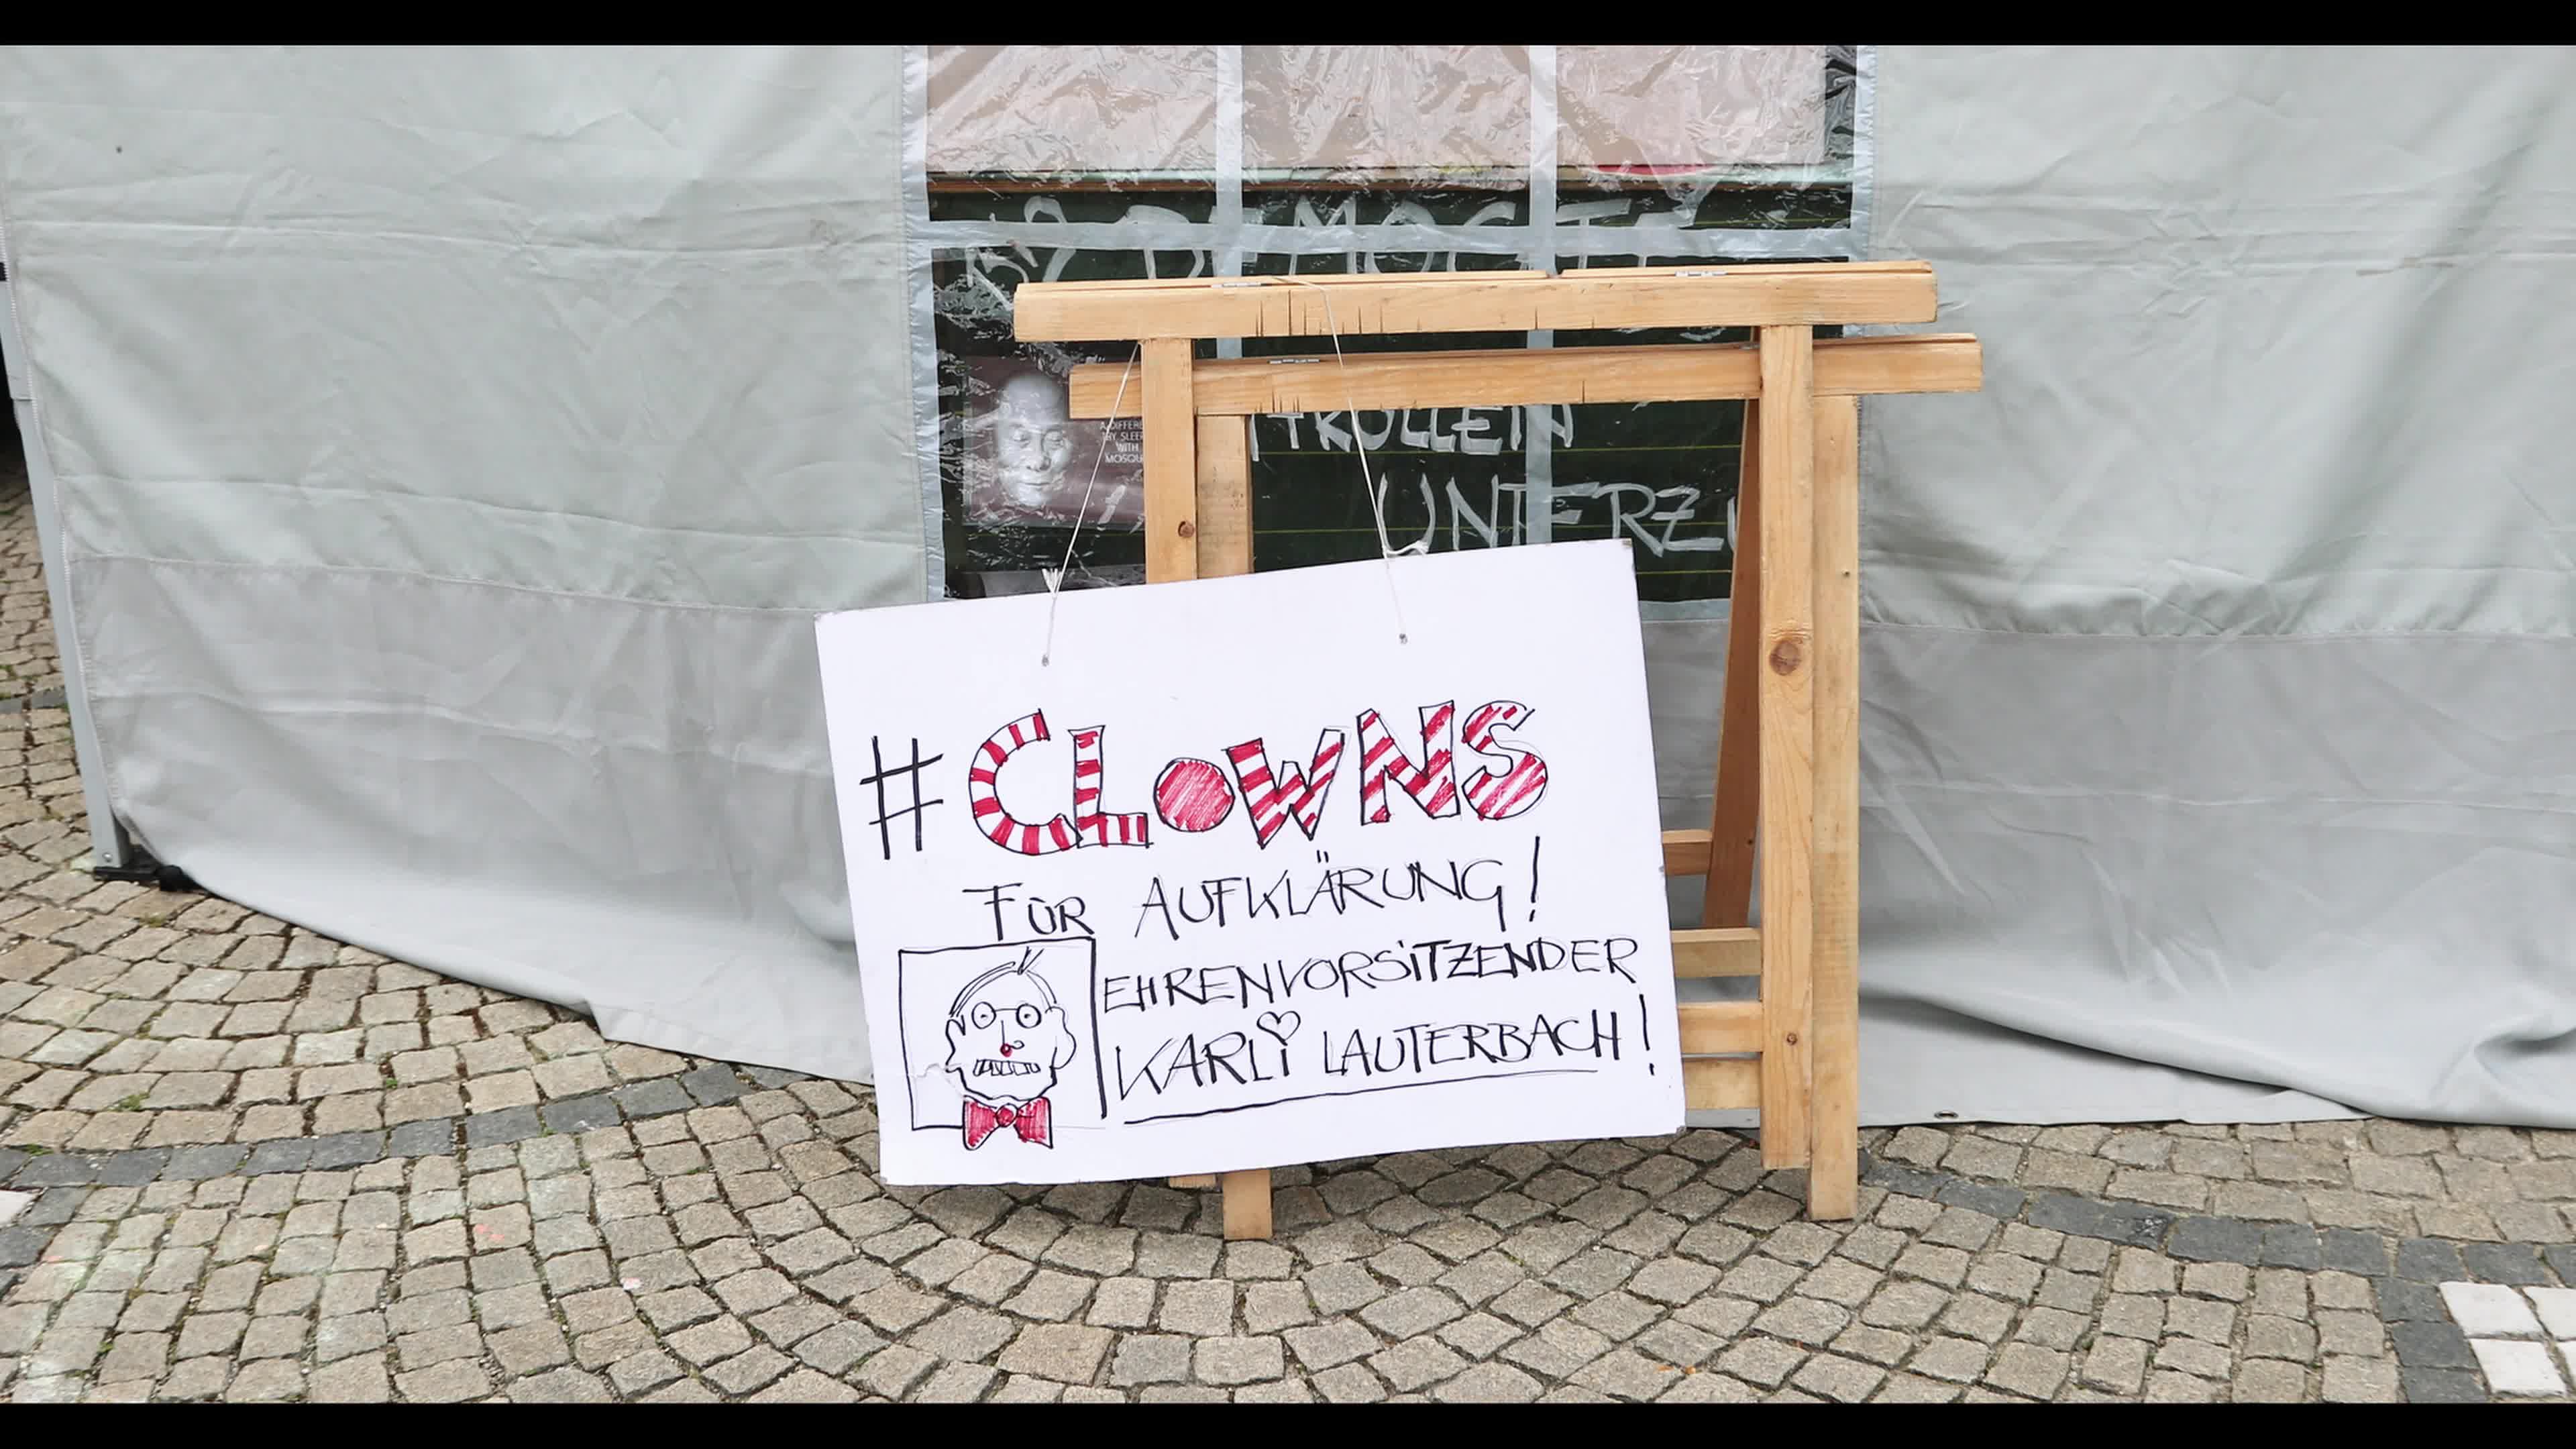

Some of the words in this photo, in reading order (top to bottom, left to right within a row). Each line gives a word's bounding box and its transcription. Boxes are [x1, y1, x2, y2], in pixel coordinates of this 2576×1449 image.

[1115, 441, 1139, 452] WITH
[1375, 472, 1739, 558] UNTERZ
[1135, 835, 1540, 941] AUFKLÄRUNG!
[1323, 993, 1656, 1075] LAUTERBACH!
